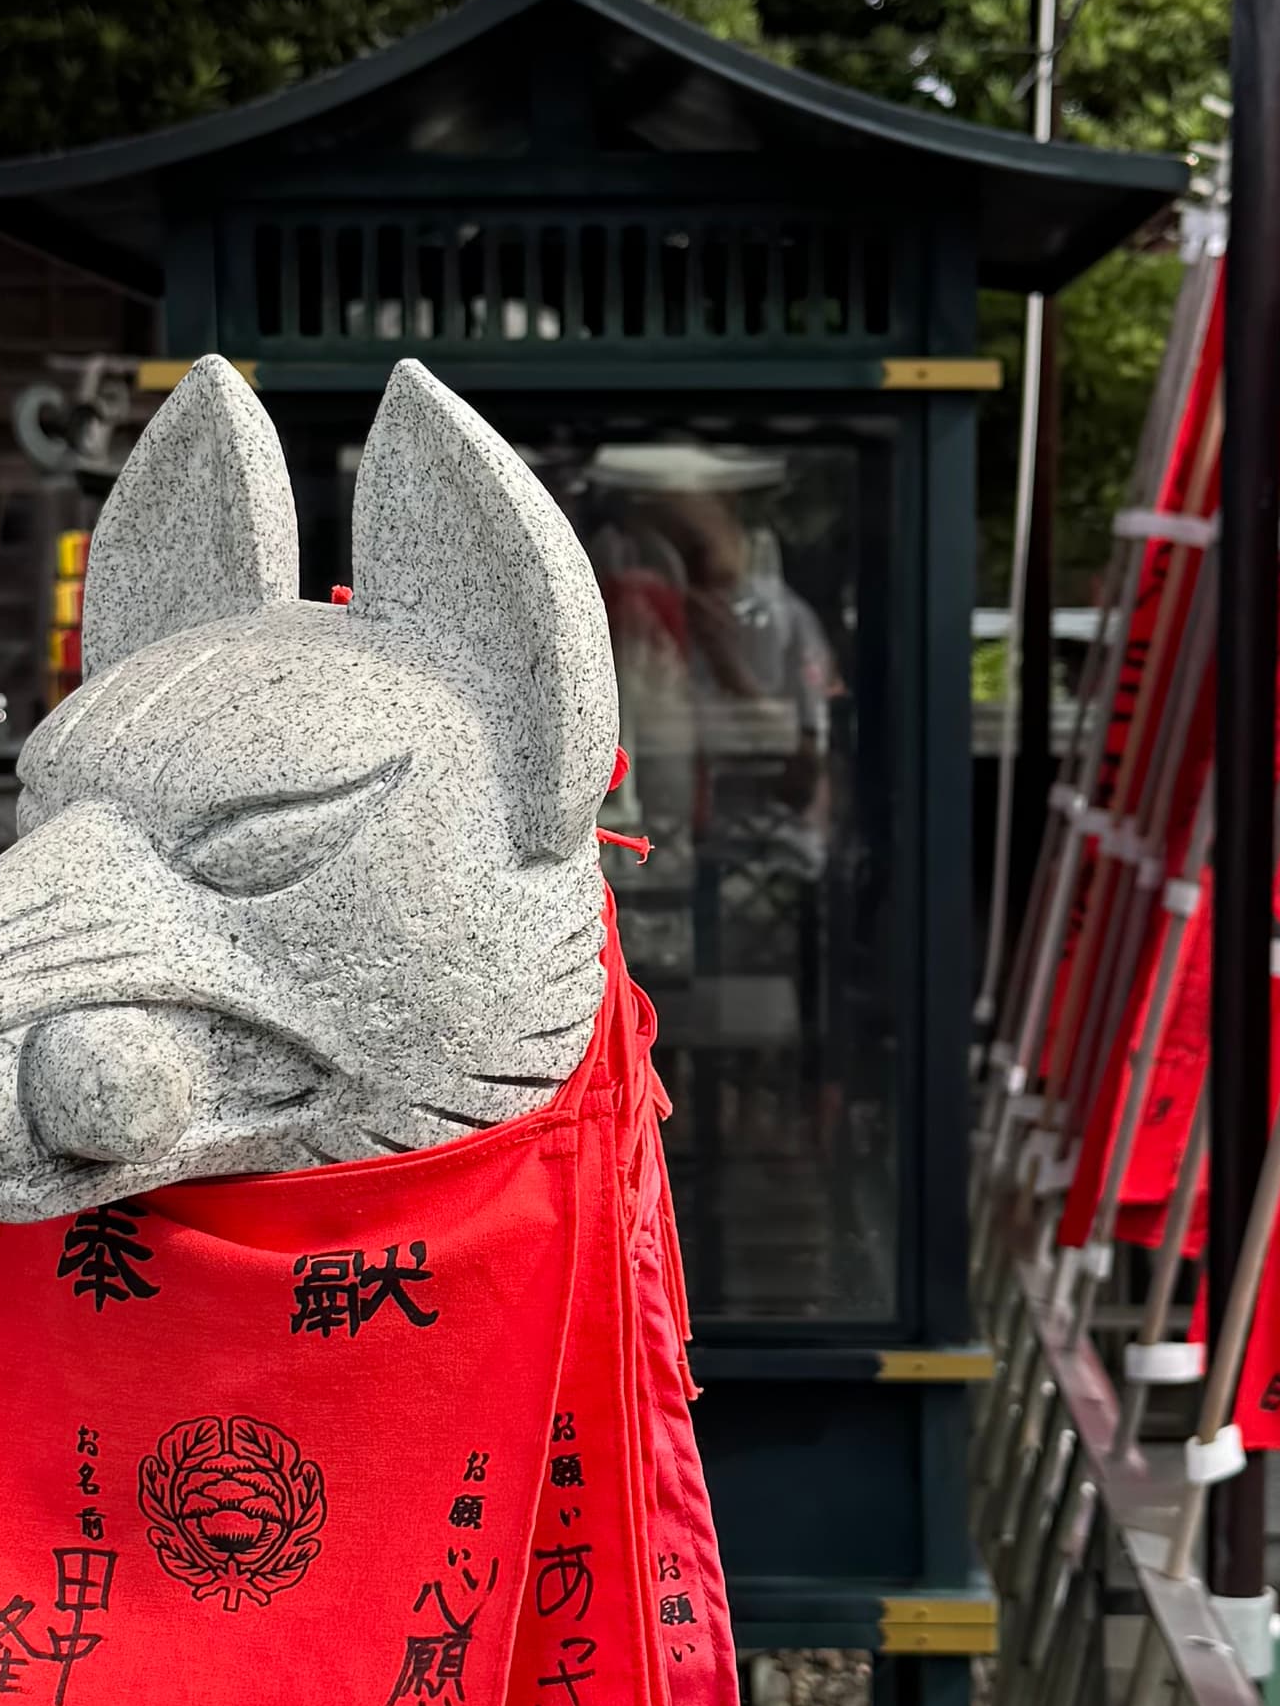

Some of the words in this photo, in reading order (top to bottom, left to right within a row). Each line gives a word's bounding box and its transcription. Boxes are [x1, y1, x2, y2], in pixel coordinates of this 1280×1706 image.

[76, 1425, 105, 1541] お名前
[448, 1450, 491, 1569] お願い
[548, 1410, 587, 1530] お願い
[657, 1551, 699, 1666] お願い
